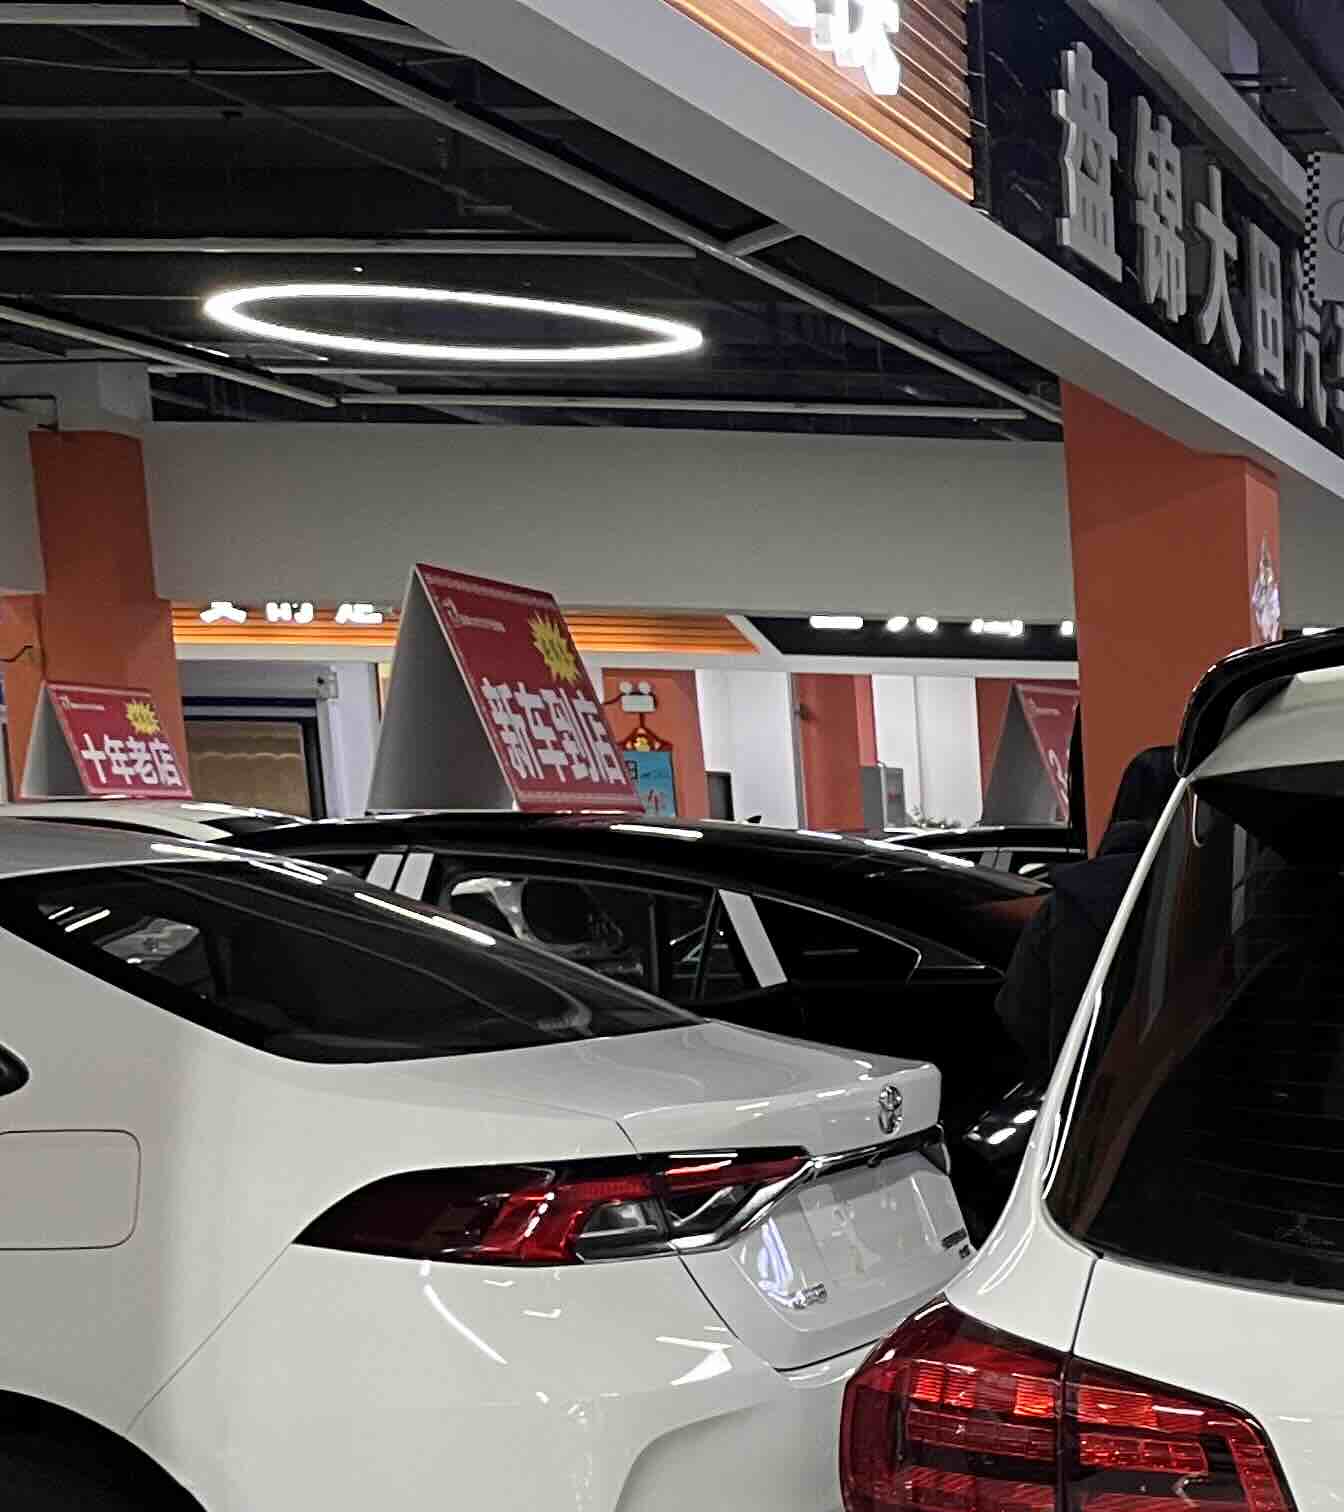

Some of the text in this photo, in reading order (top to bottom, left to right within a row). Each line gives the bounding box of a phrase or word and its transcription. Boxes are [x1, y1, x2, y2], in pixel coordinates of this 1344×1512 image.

[80, 732, 183, 787] 十年老店
[480, 676, 628, 785] 新车到店
